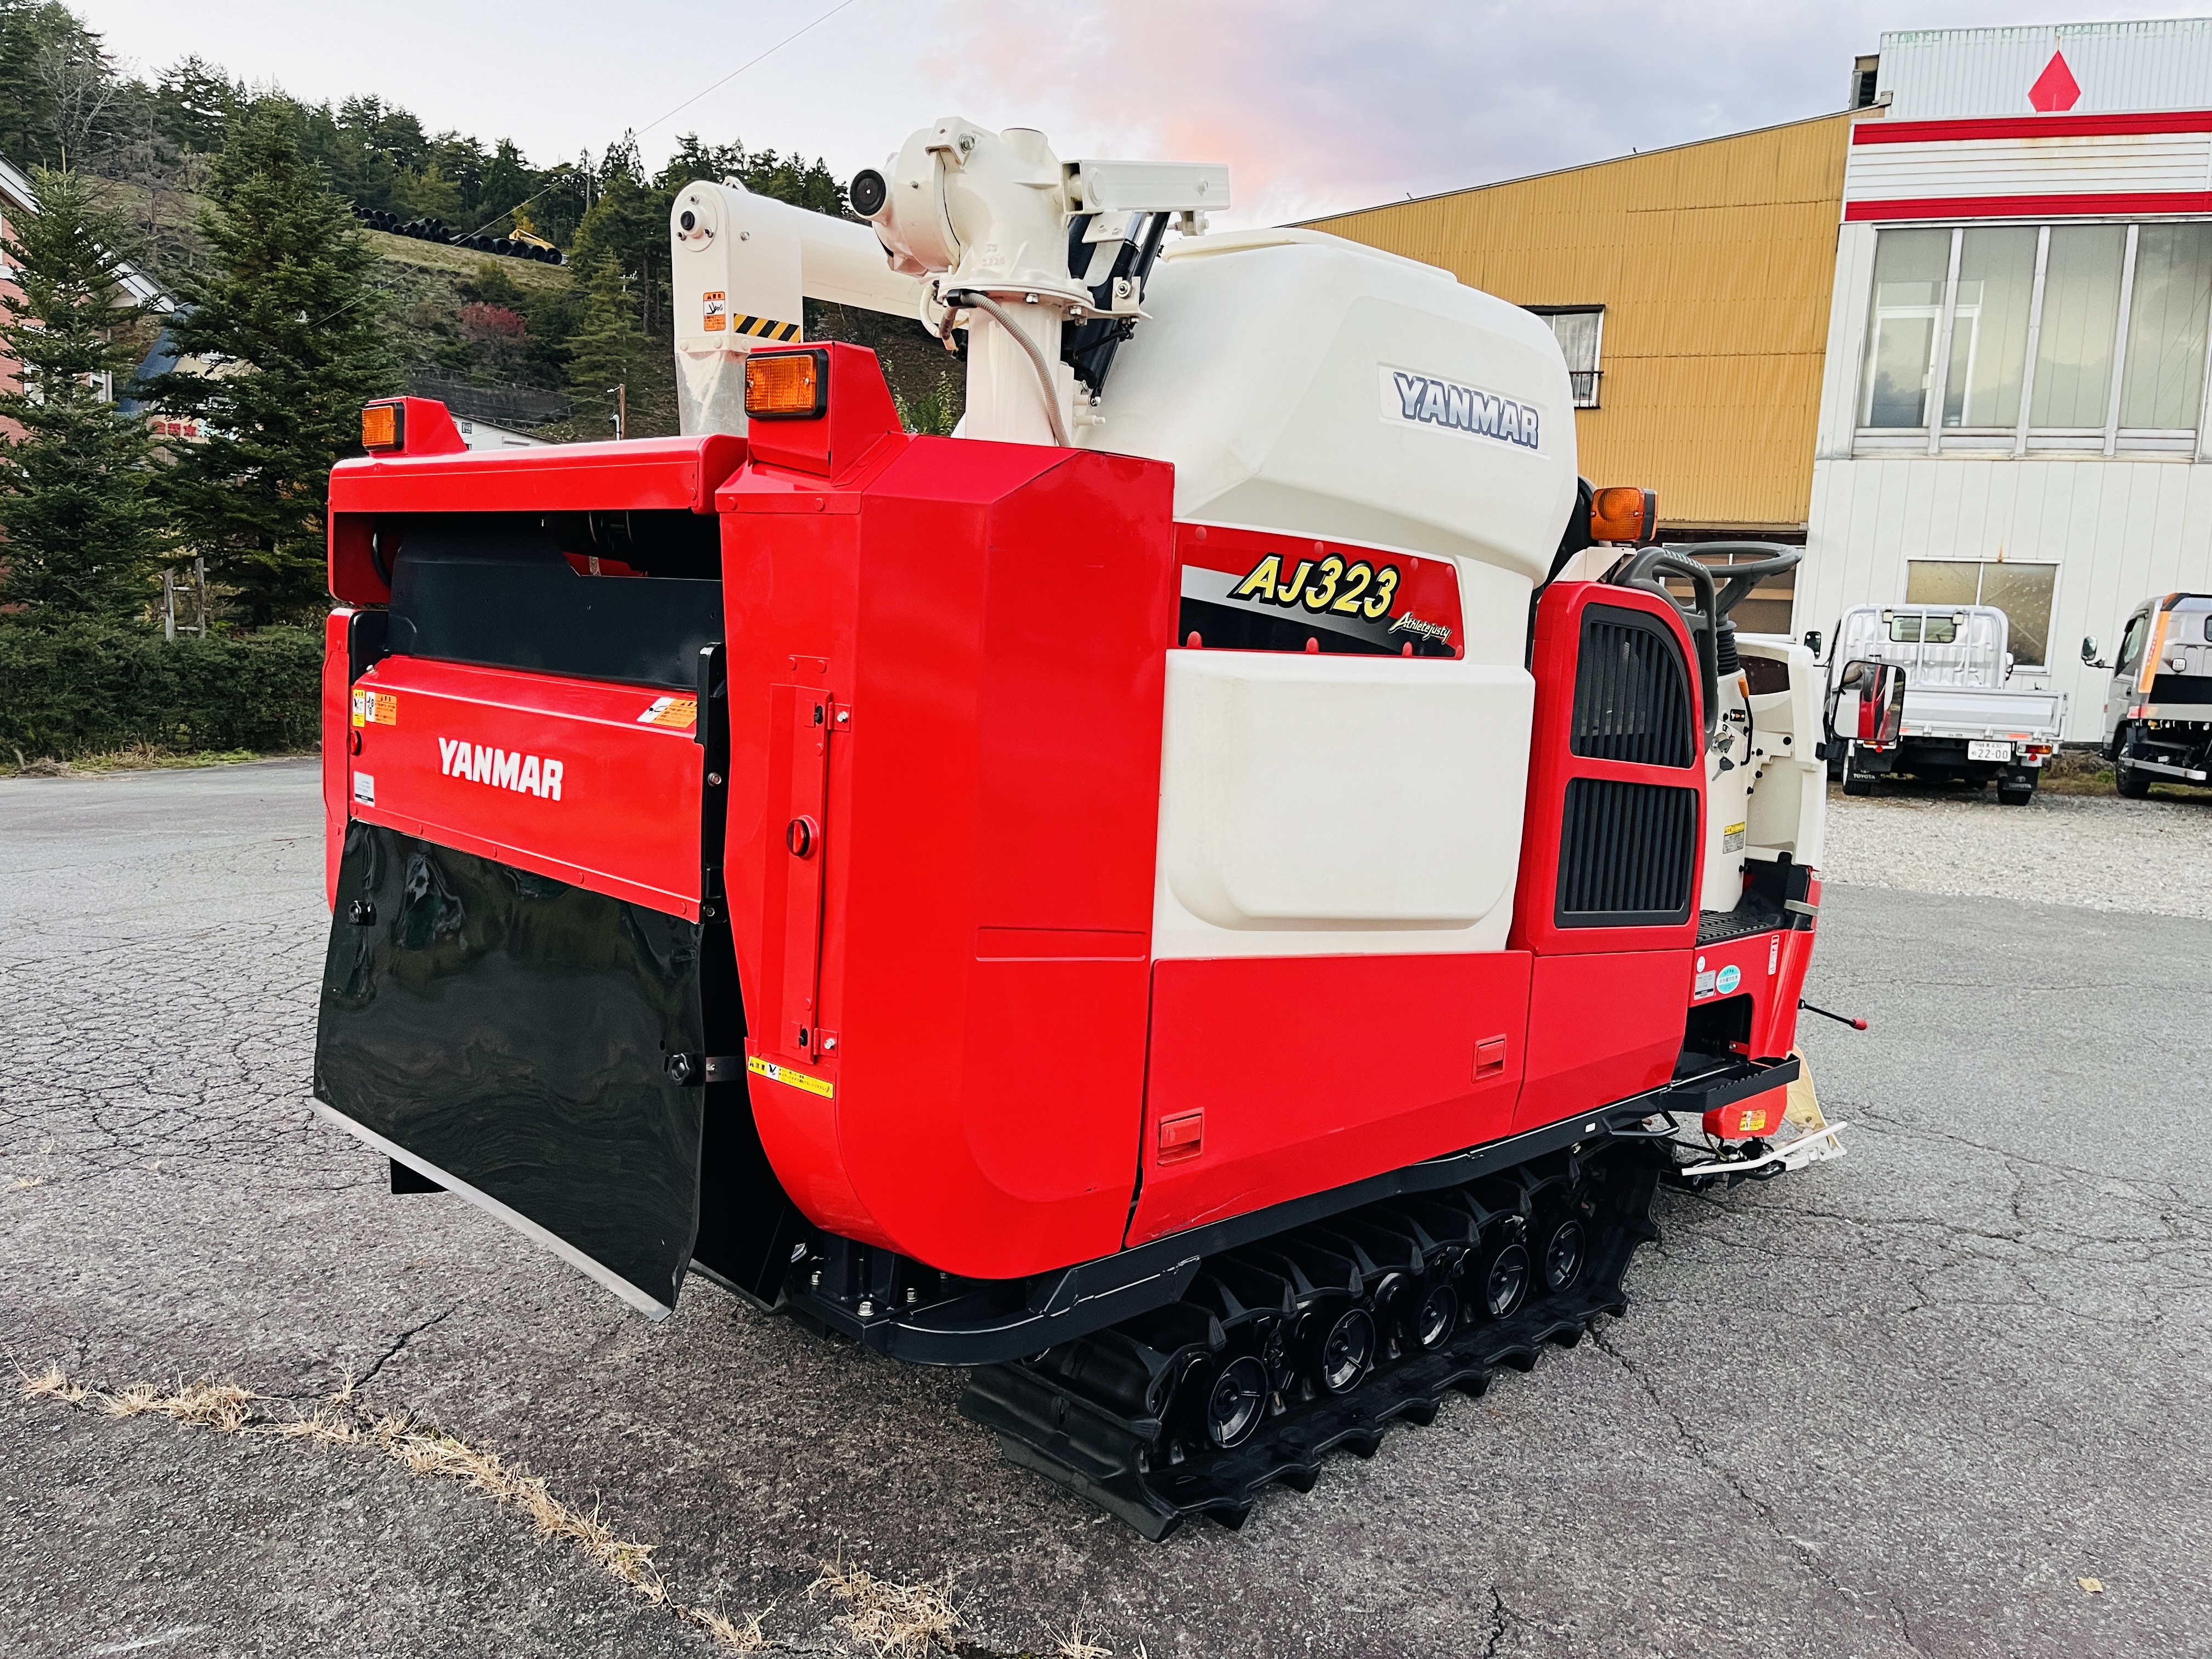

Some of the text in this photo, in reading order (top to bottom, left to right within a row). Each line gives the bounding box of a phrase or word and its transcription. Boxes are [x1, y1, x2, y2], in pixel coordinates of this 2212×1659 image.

[1393, 371, 1538, 450] YANMAR
[1229, 554, 1400, 622] AJ323
[1389, 612, 1452, 644] Athletejusty
[438, 737, 563, 802] YANMAR
